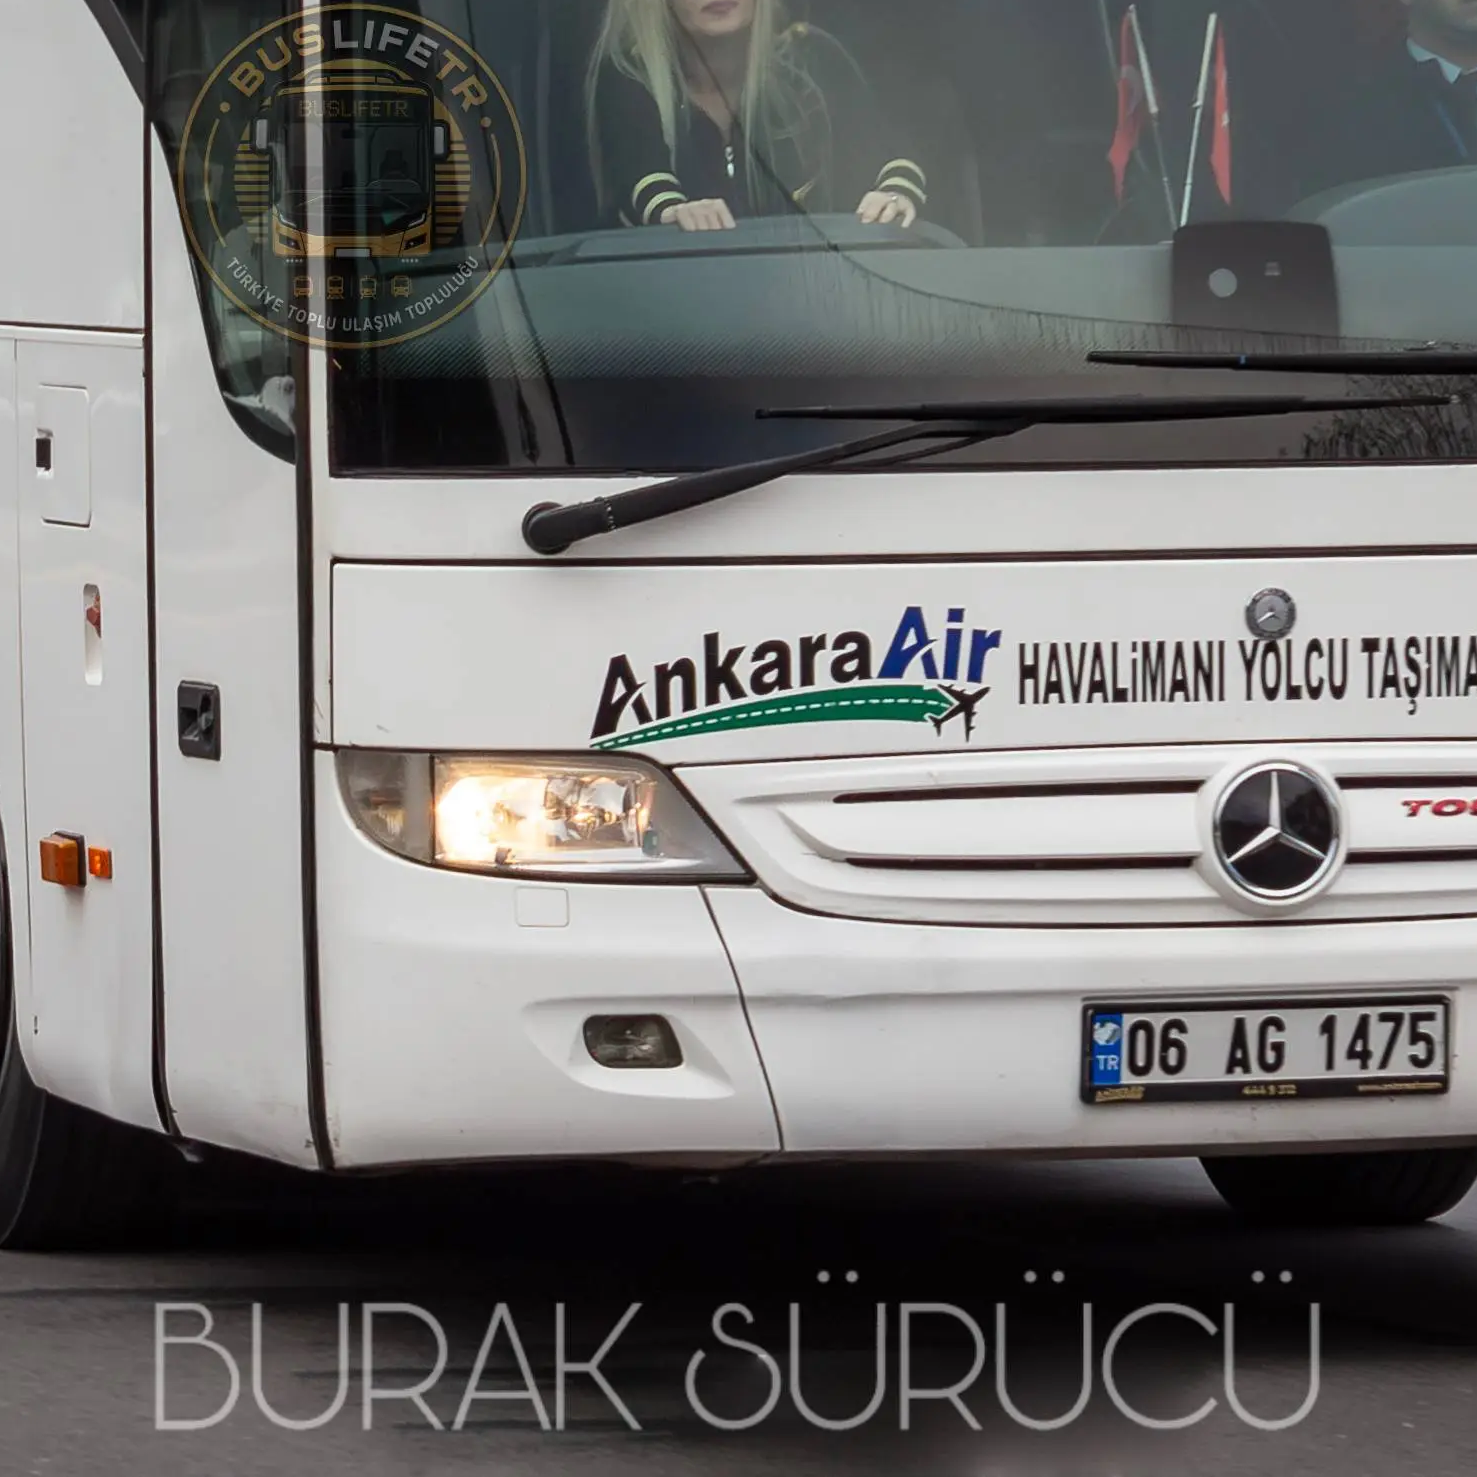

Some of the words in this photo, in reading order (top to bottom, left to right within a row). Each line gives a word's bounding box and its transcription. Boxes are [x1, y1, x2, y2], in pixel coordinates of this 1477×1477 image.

[1239, 637, 1349, 702] YOLCU
[1095, 1053, 1120, 1071] TR
[1127, 1017, 1190, 1077] 06
[1224, 1015, 1287, 1075] AG
[1319, 1010, 1439, 1072] 1475
